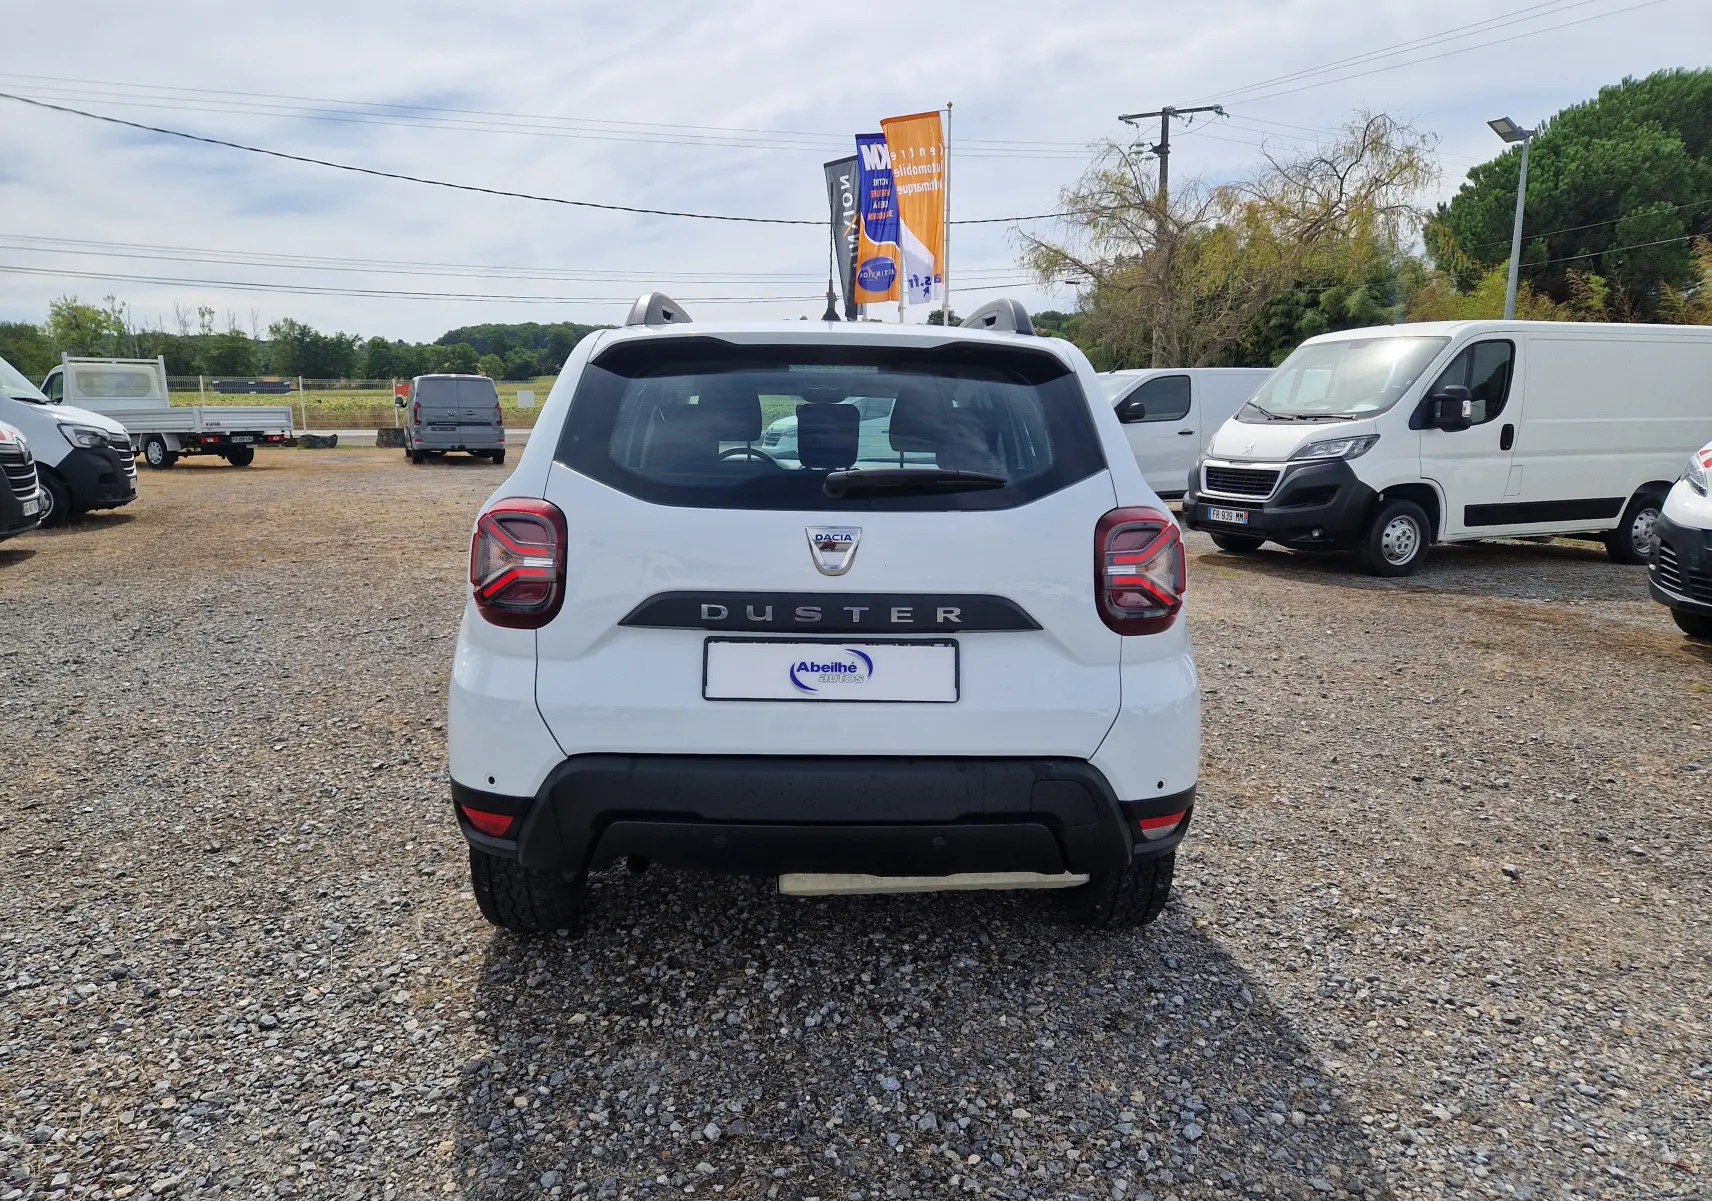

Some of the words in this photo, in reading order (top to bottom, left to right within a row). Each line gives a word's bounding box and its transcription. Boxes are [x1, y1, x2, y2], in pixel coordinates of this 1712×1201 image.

[815, 533, 853, 541] DACIA
[701, 603, 962, 623] DUSTER
[796, 661, 858, 673] Abeilhé
[818, 671, 865, 683] autos
